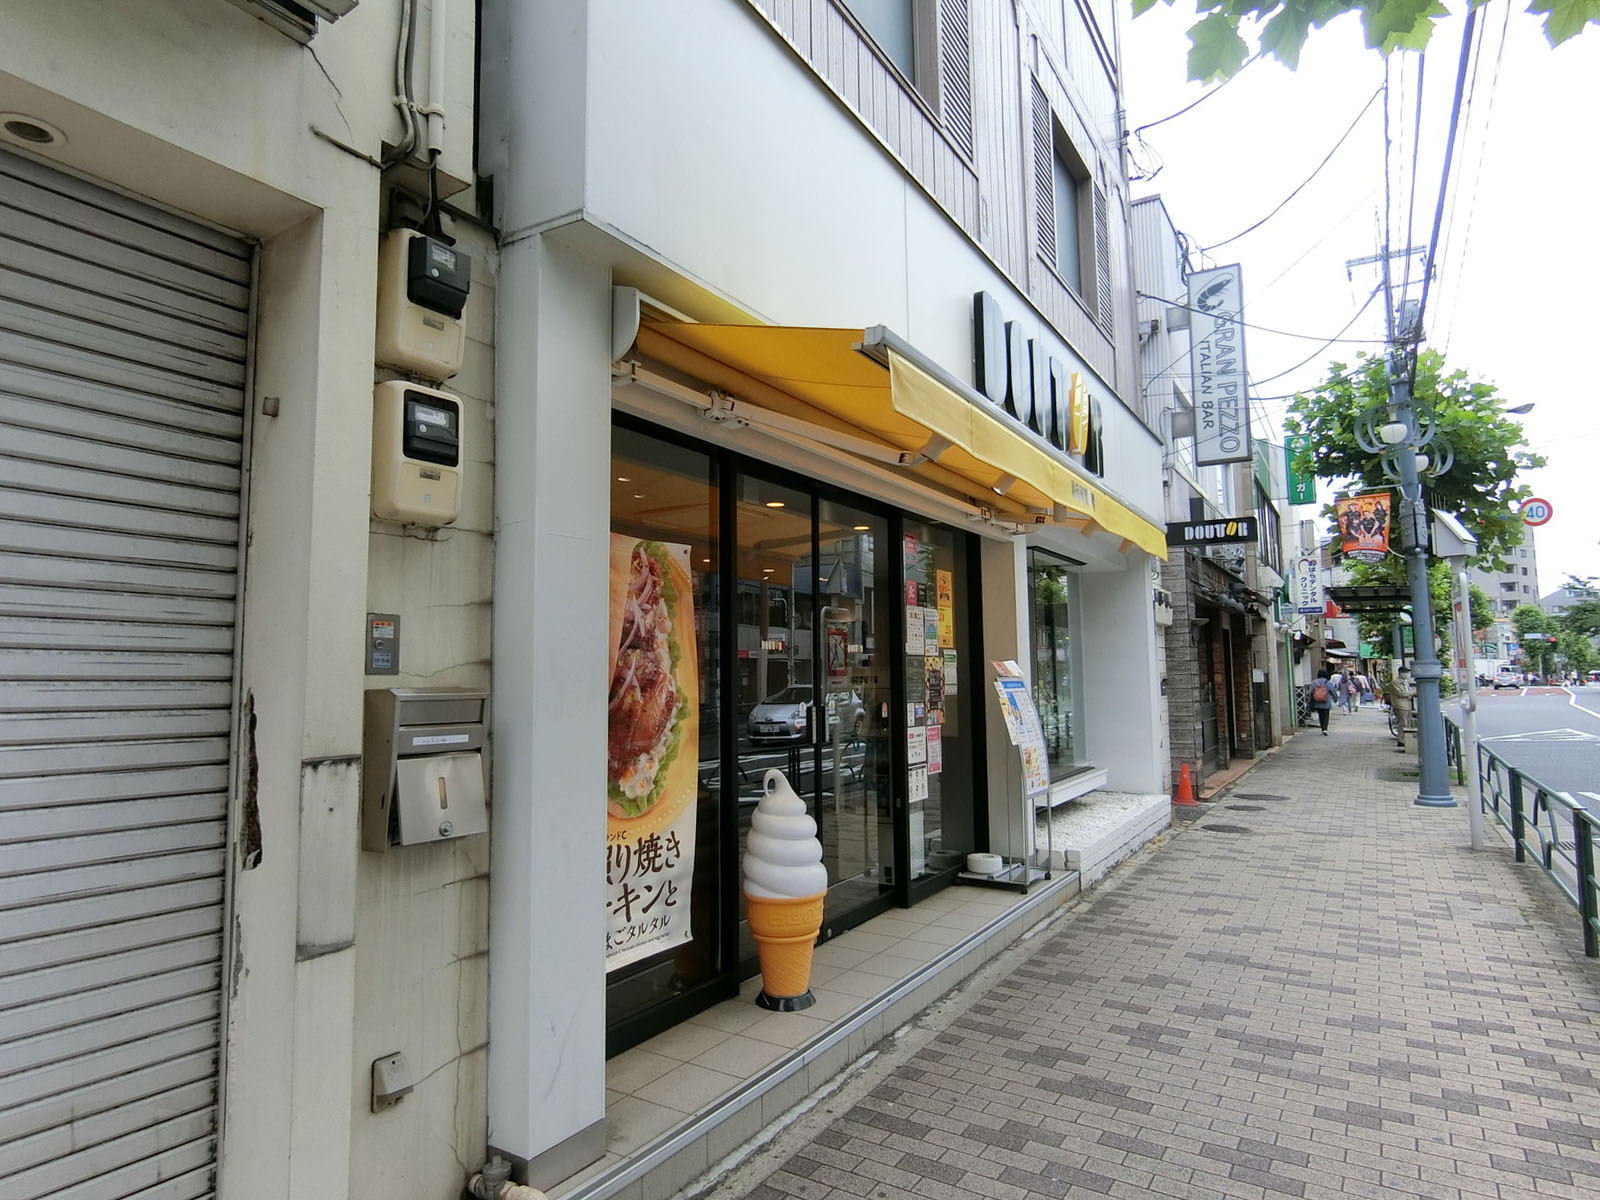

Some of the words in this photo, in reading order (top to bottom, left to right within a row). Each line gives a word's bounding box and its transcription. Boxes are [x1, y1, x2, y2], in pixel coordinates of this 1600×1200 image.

[1200, 340, 1213, 394] ITALIAN
[1214, 311, 1237, 376] GRAN
[1202, 401, 1215, 430] BAR
[1217, 381, 1241, 453] PEZZO
[1184, 521, 1248, 540] DOUTOR
[1526, 505, 1546, 519] 40
[607, 830, 680, 885] り焼き
[606, 879, 678, 923] キンと
